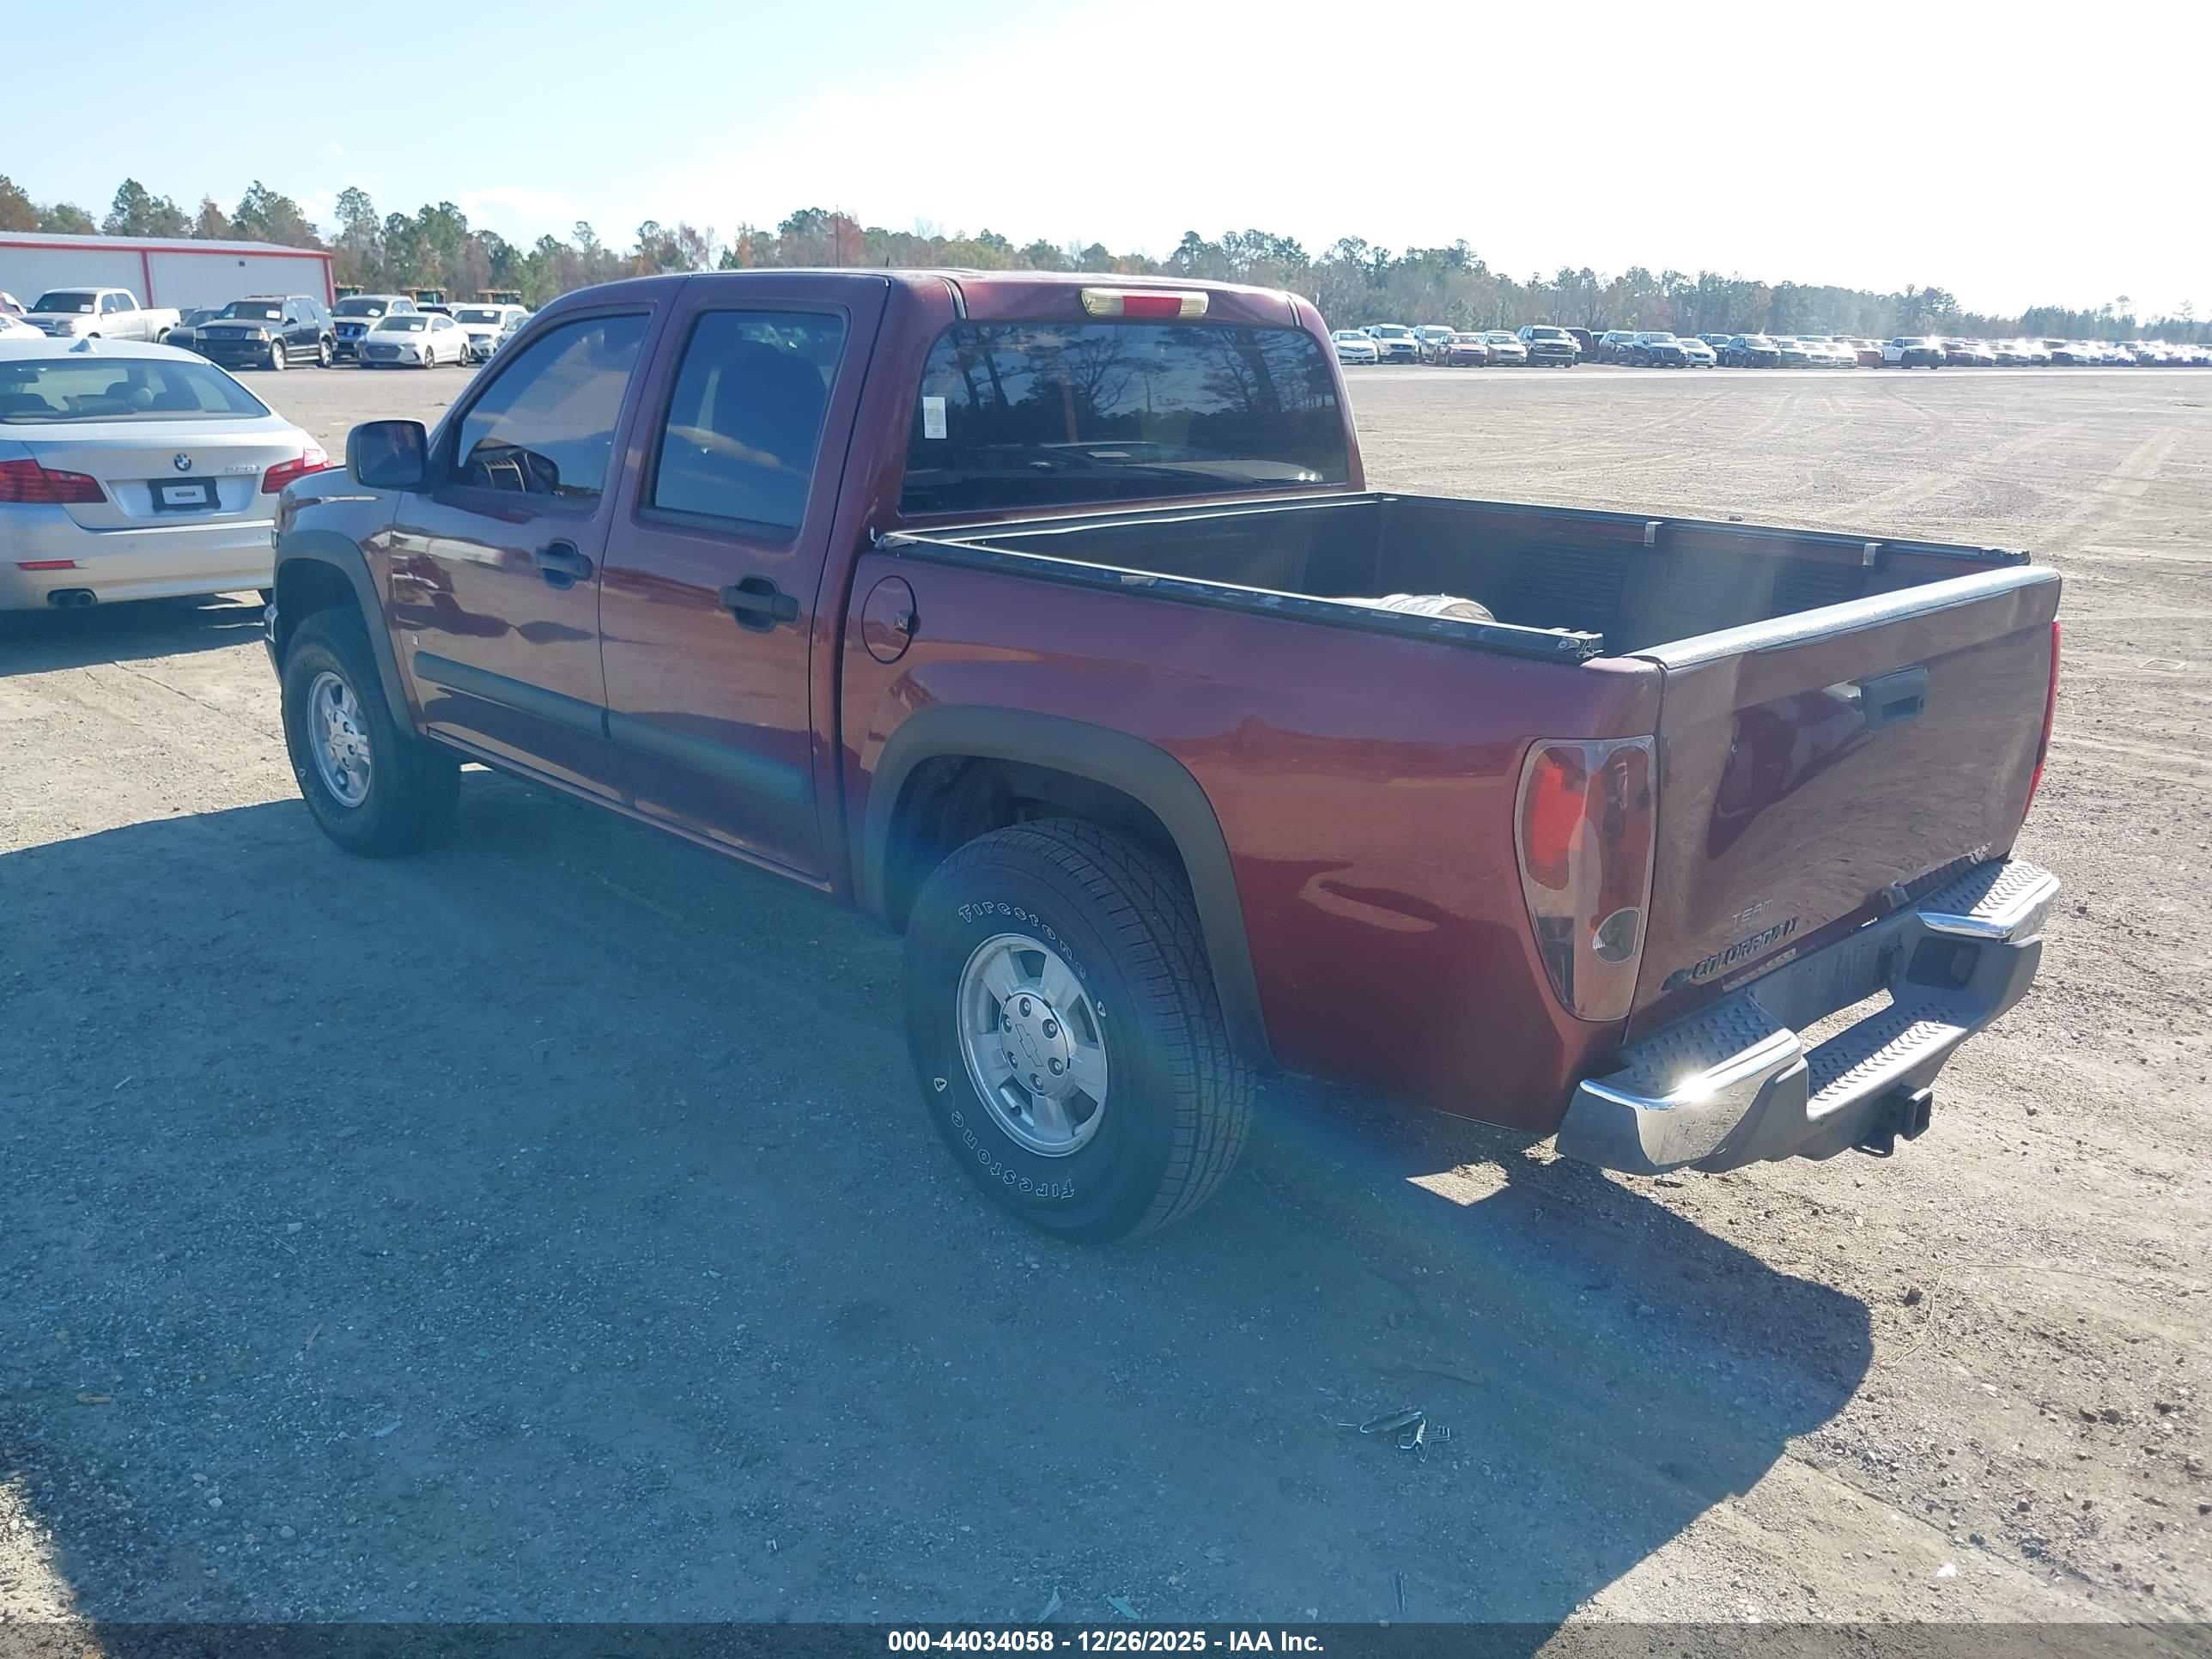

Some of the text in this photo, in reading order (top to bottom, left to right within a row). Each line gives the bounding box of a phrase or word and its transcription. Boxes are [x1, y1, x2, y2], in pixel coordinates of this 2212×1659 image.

[957, 901, 1087, 980] Firestone
[1692, 923, 1784, 980] COLORADO
[951, 1109, 1075, 1200] Firestone
